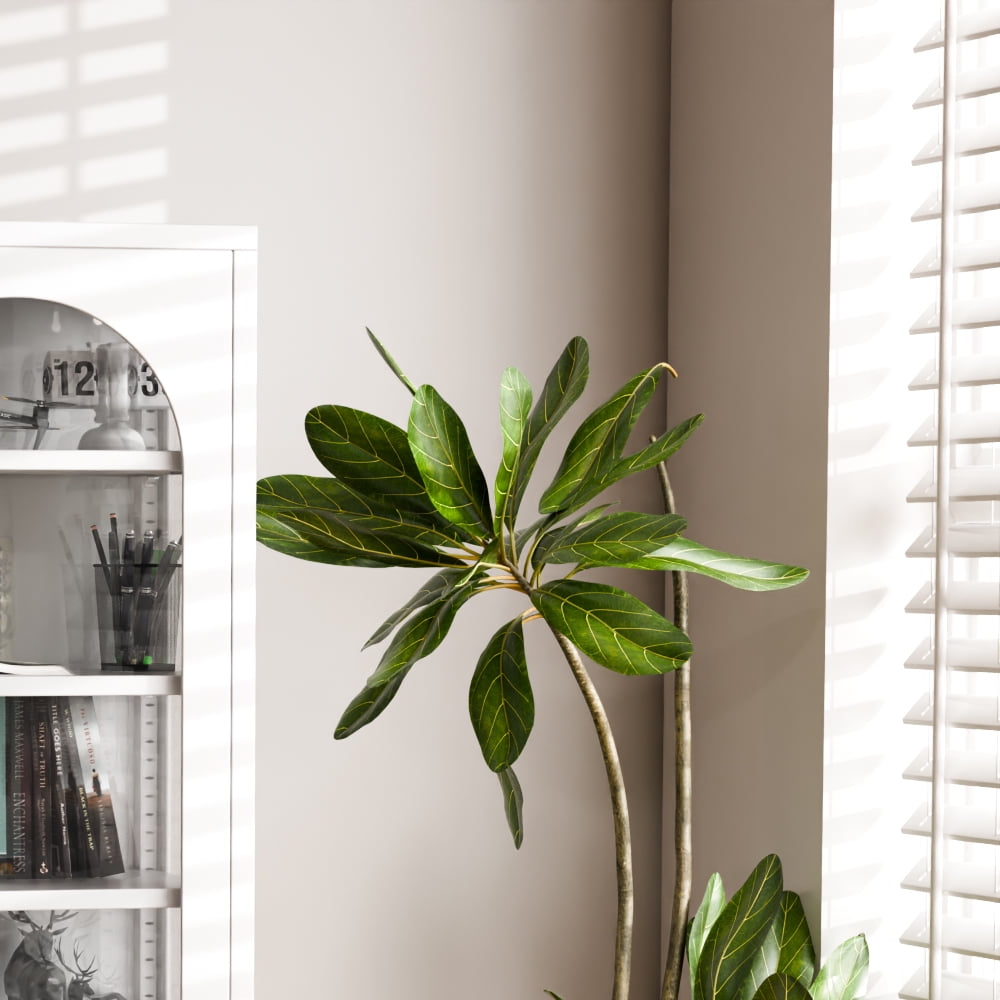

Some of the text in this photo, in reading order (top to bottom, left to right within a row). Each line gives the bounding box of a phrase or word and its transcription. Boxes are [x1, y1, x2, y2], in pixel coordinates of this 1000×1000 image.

[54, 361, 95, 396] 12
[14, 732, 25, 778] MAXWELL
[51, 705, 63, 776] TITLE GOES HERE
[12, 792, 26, 873] ENCHANTRESS
